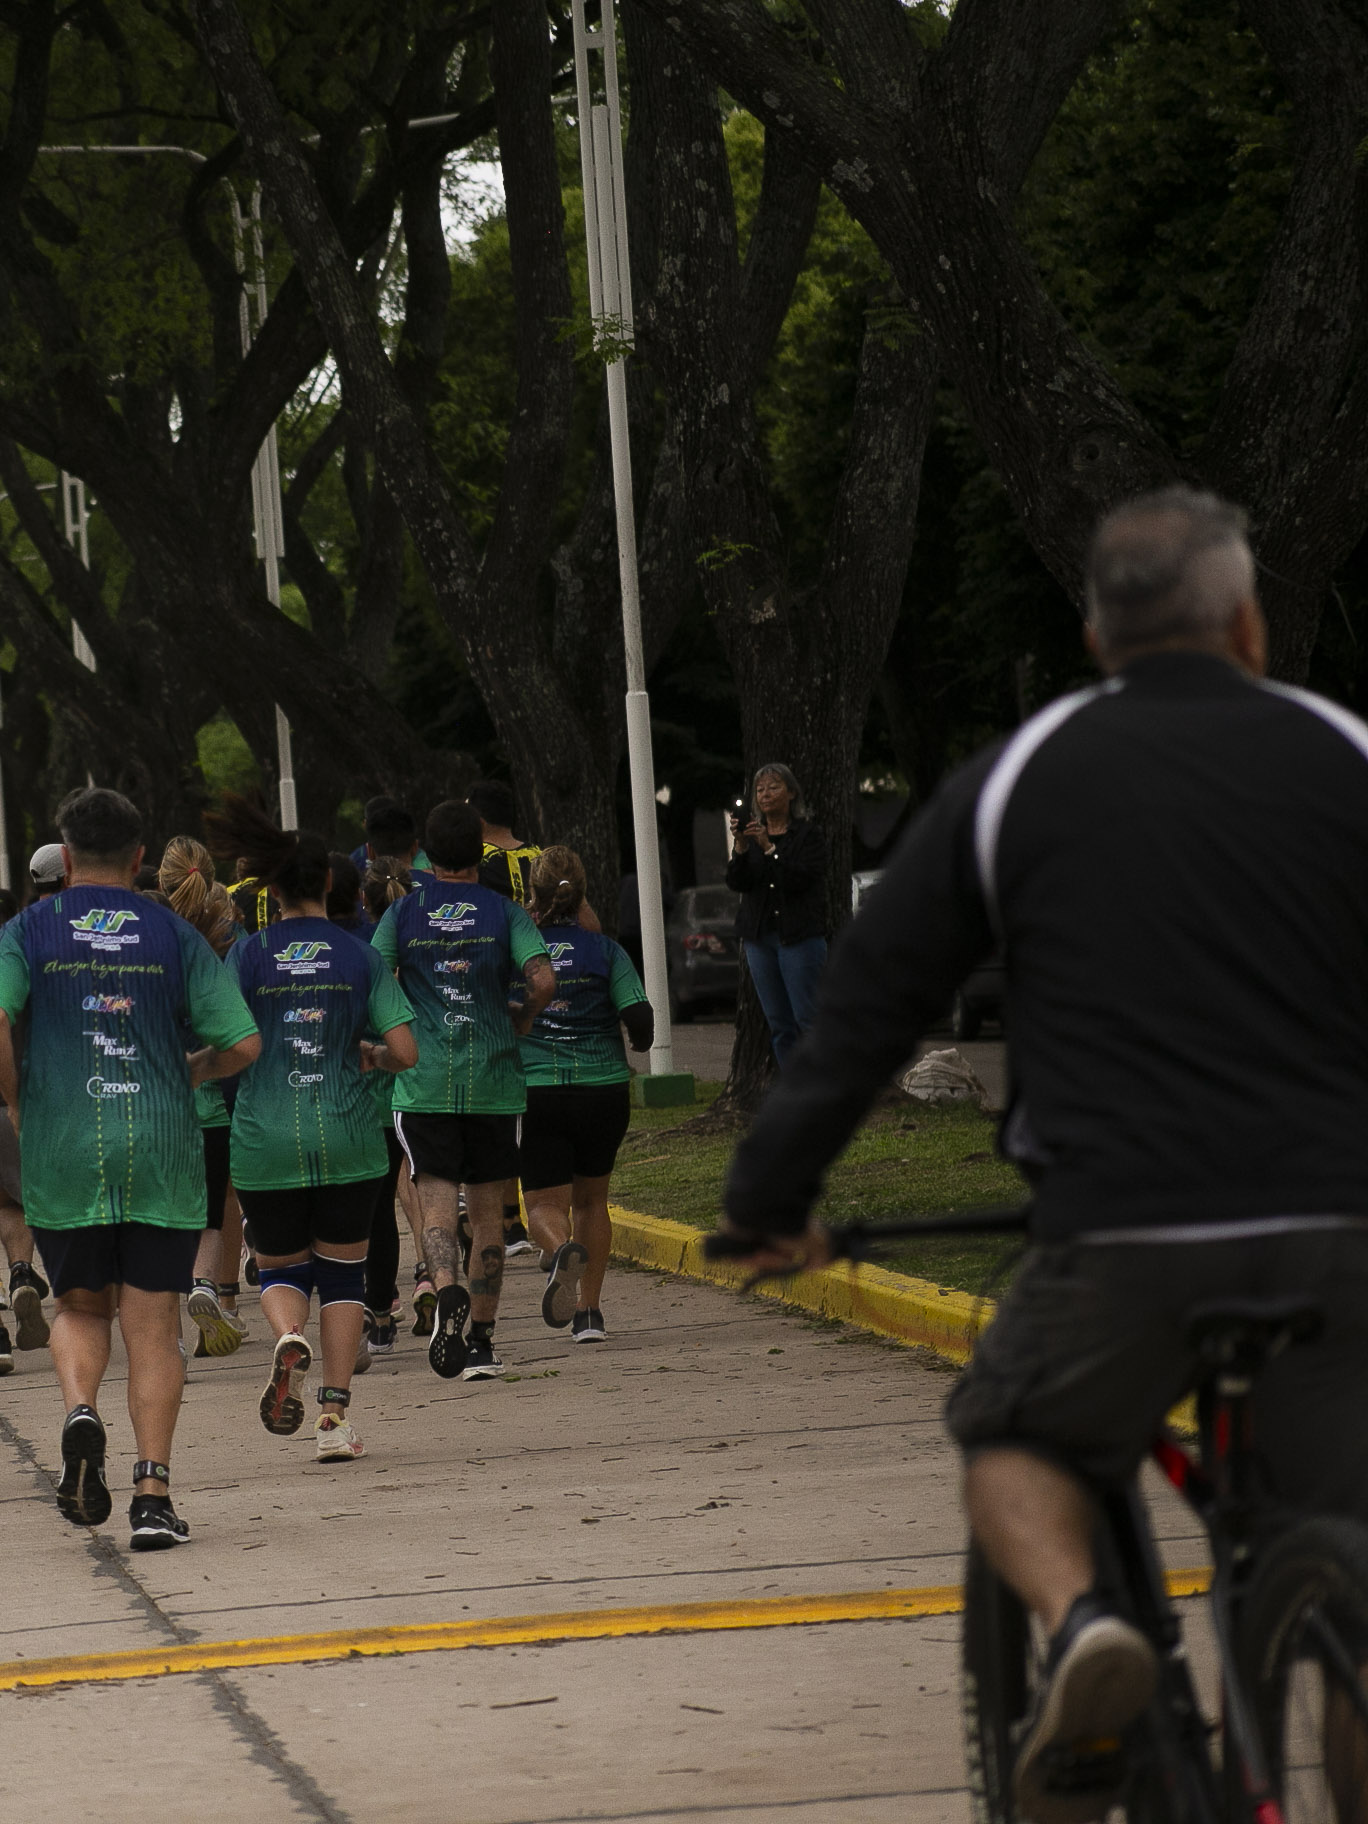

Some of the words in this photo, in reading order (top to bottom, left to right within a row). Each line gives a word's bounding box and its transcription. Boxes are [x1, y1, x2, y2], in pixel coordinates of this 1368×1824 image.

[93, 1035, 118, 1046] Max
[293, 1039, 312, 1047] Max
[104, 1046, 127, 1056] Run
[288, 1071, 324, 1088] CRONO
[86, 1076, 141, 1098] CRONO
